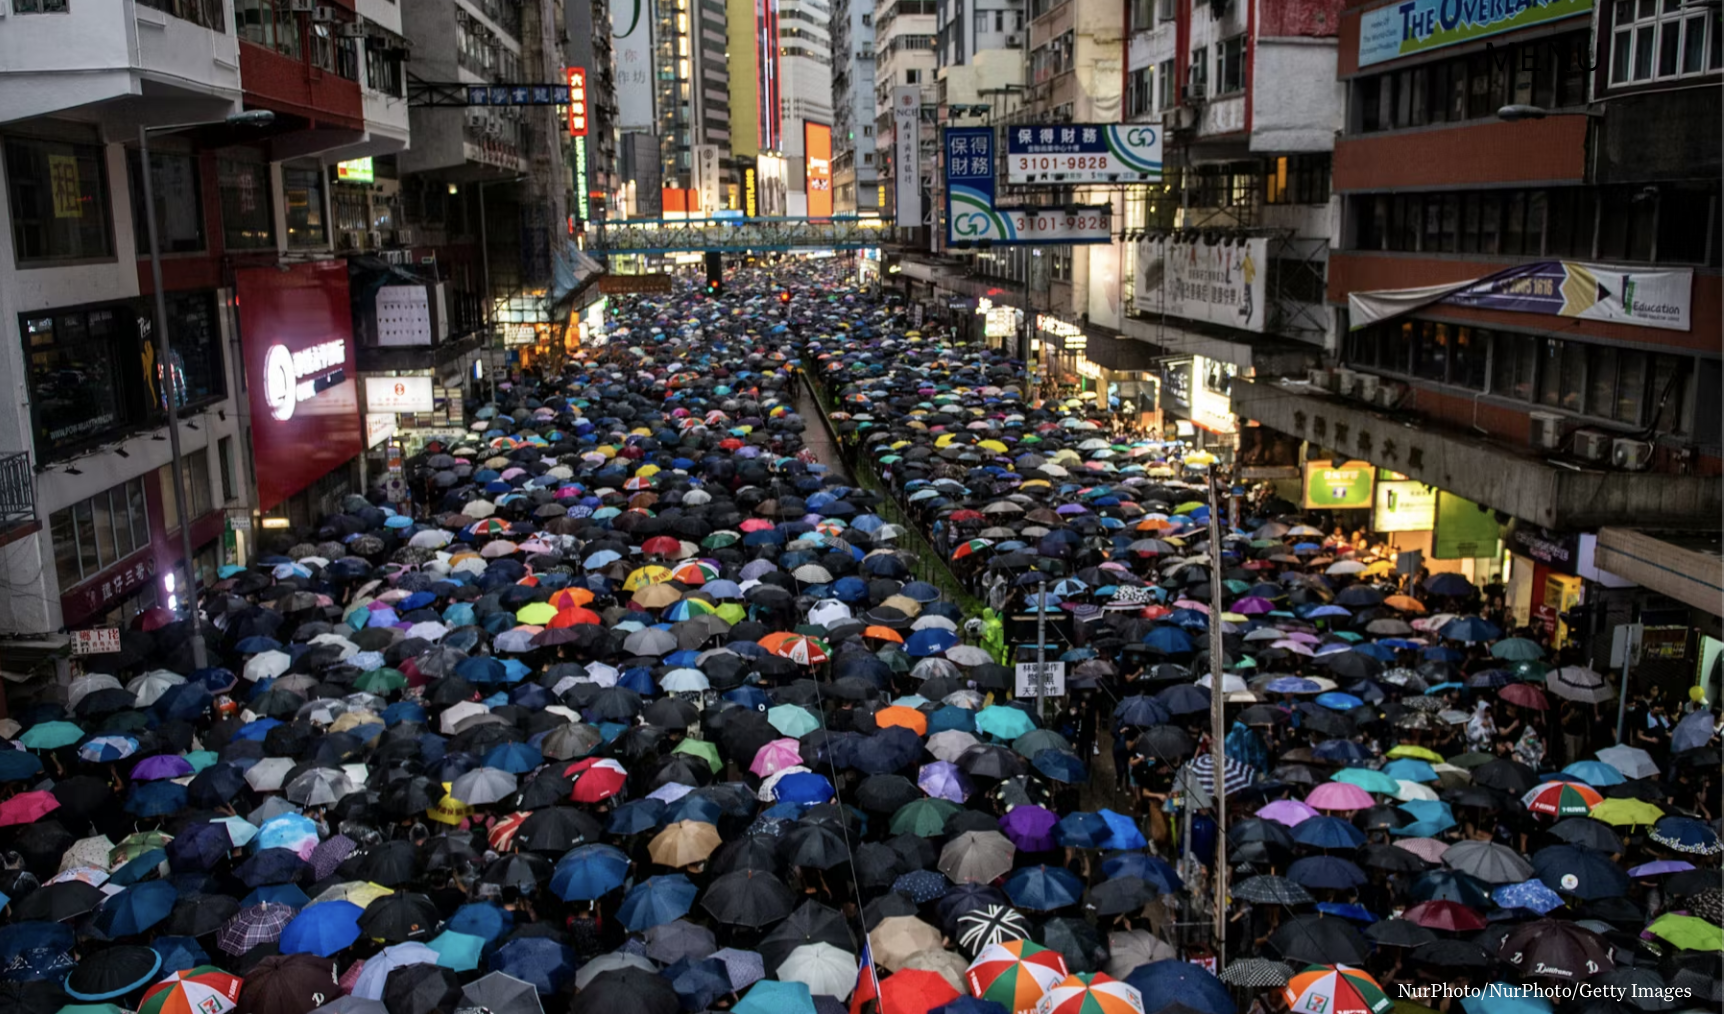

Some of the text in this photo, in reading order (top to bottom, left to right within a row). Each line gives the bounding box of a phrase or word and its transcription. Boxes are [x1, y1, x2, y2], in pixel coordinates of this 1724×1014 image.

[1399, 0, 1561, 41] THE OVERL
[1018, 128, 1097, 144] 保得財務
[951, 137, 988, 155] 保得
[951, 157, 989, 176] 財務
[1019, 156, 1108, 171] 3101-9828
[52, 162, 80, 212] 租
[1016, 216, 1108, 231] 3101-9828
[1632, 299, 1680, 315] Education
